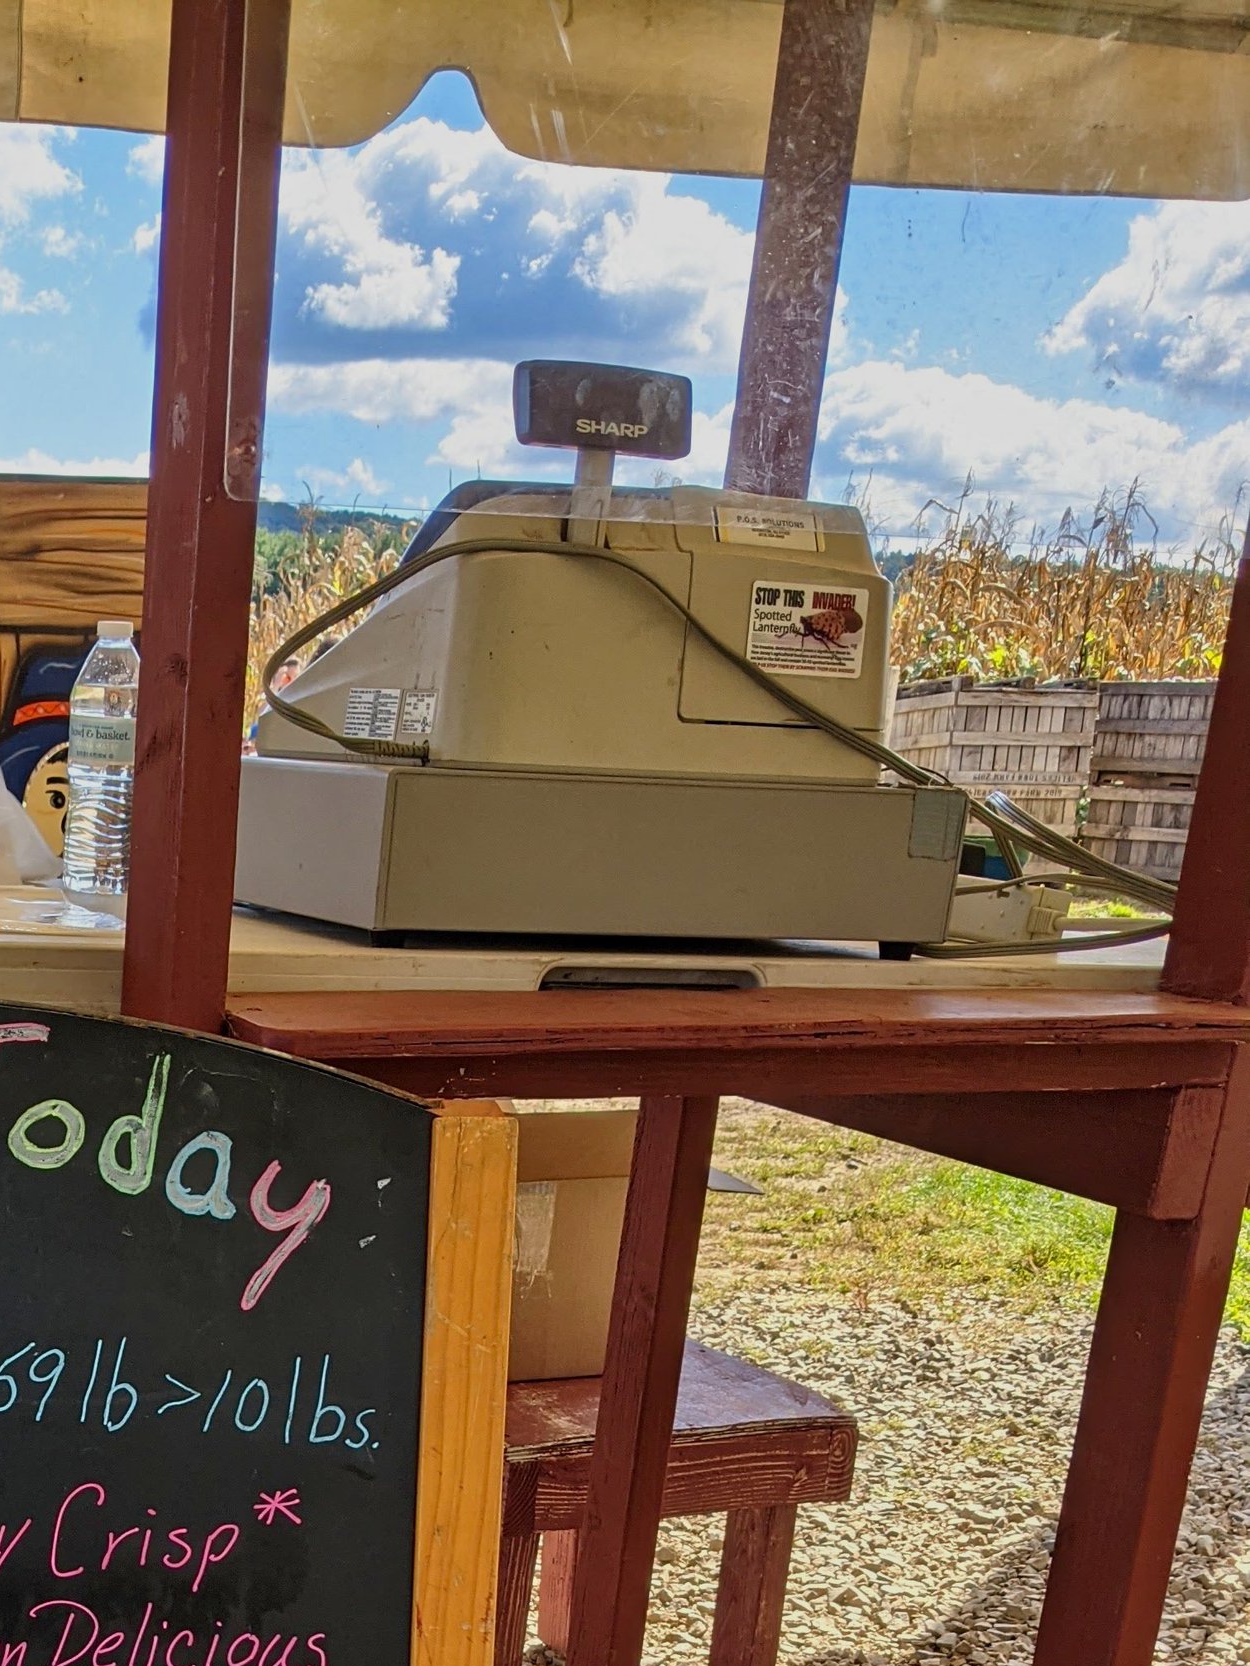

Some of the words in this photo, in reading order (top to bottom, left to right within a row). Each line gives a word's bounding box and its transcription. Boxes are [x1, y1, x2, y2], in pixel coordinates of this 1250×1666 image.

[576, 419, 649, 438] SHARP
[736, 515, 759, 525] P.O.S.
[762, 518, 805, 529] SOLUTIONS
[755, 587, 780, 606] STOP
[783, 589, 805, 608] THIS
[812, 591, 856, 611] INVADER!
[753, 608, 793, 622] Spotted
[752, 620, 801, 634] Lanternfly
